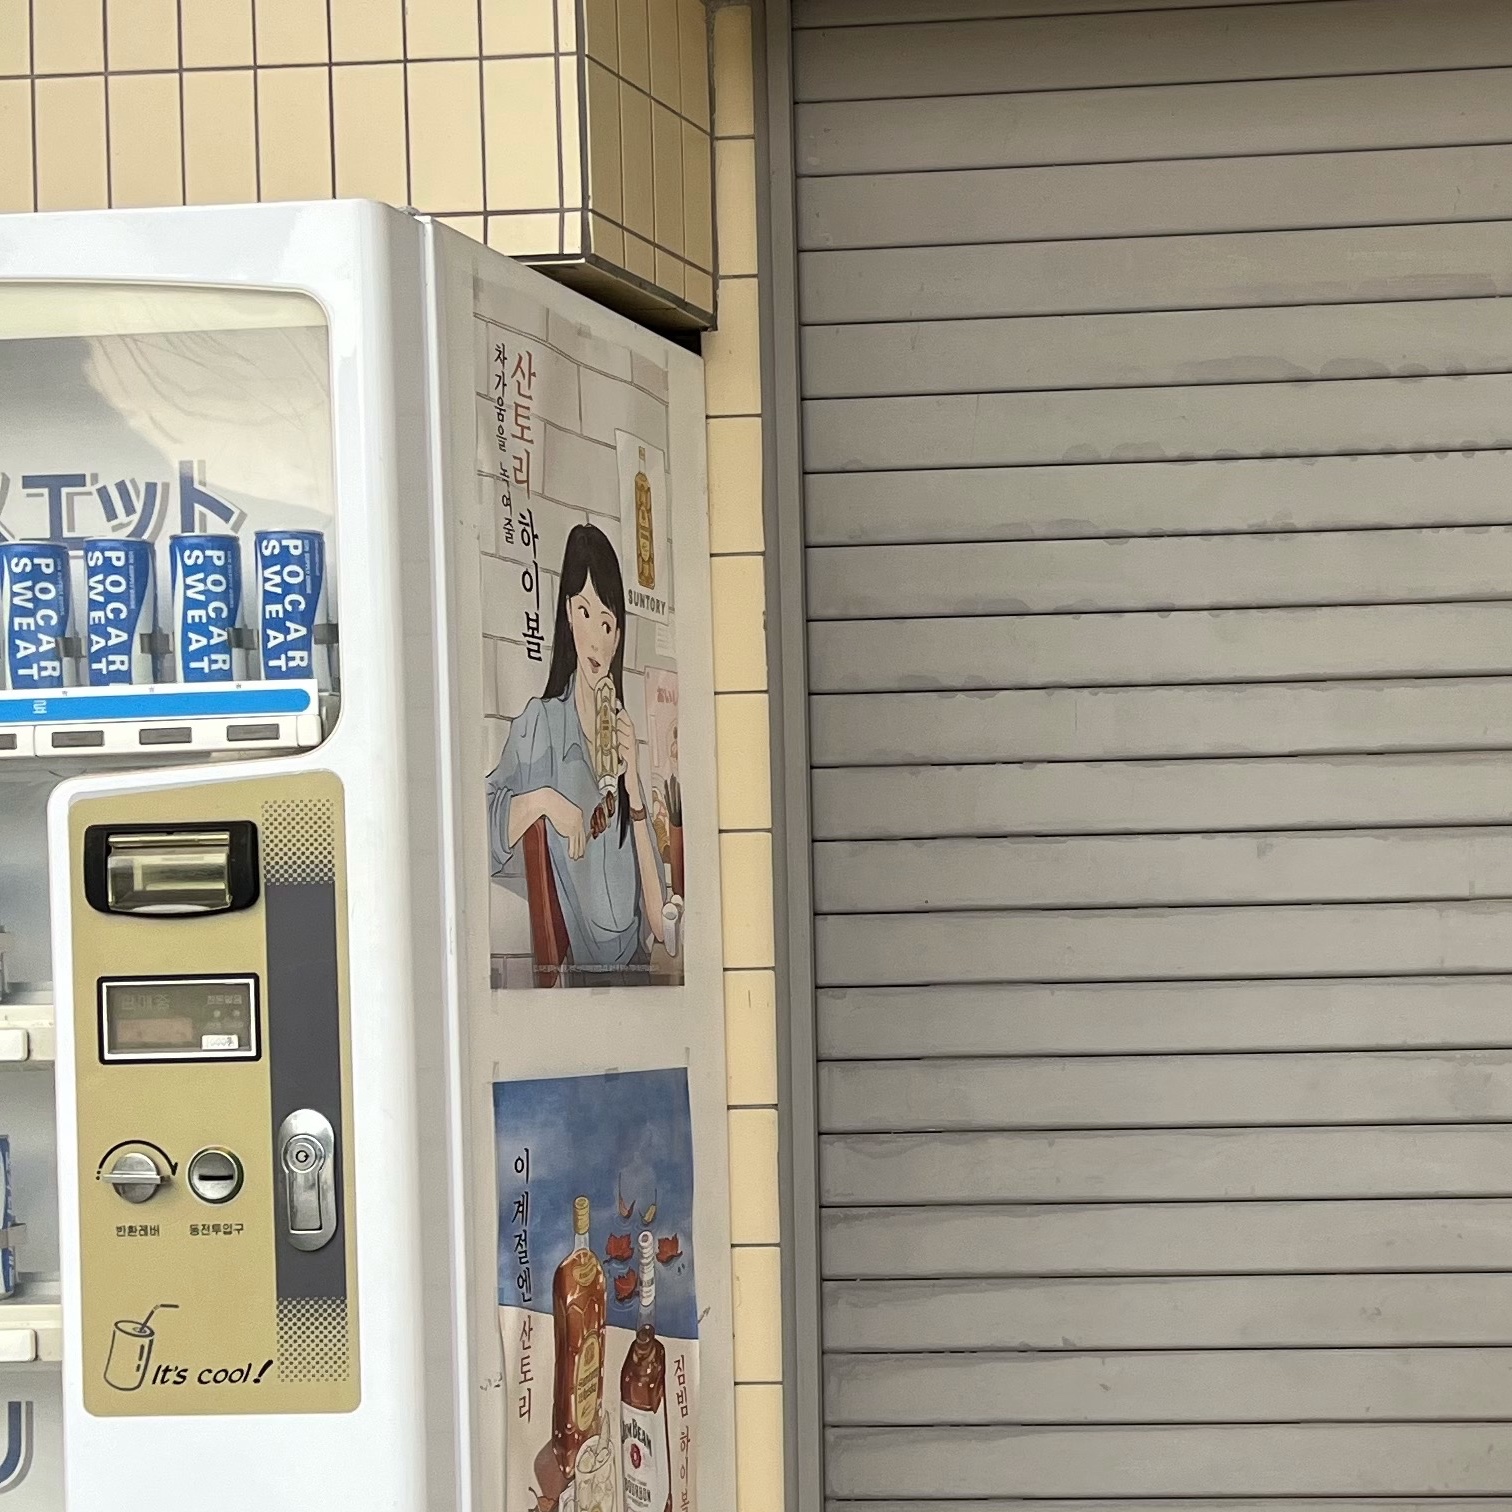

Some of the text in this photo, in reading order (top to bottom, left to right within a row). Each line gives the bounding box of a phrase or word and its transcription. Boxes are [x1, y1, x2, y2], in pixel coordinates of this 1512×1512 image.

[494, 342, 508, 453] 차가움을
[0, 460, 236, 550] エット
[511, 350, 545, 662] 산토리 하이볼
[11, 556, 39, 681] SWEAT
[33, 557, 61, 678] POCAR
[87, 550, 108, 675] SWEAT
[183, 549, 209, 674] SWEAT
[204, 549, 231, 671] POCAR
[261, 539, 287, 672] SWEAT
[281, 539, 309, 668] POCAR
[628, 588, 666, 616] SUNTORY
[115, 1224, 160, 1237] 반환레버
[189, 1222, 244, 1236] 동전투입구
[151, 1363, 189, 1385] It's
[519, 1314, 534, 1424] 산토리
[674, 1354, 689, 1418] 짐빔
